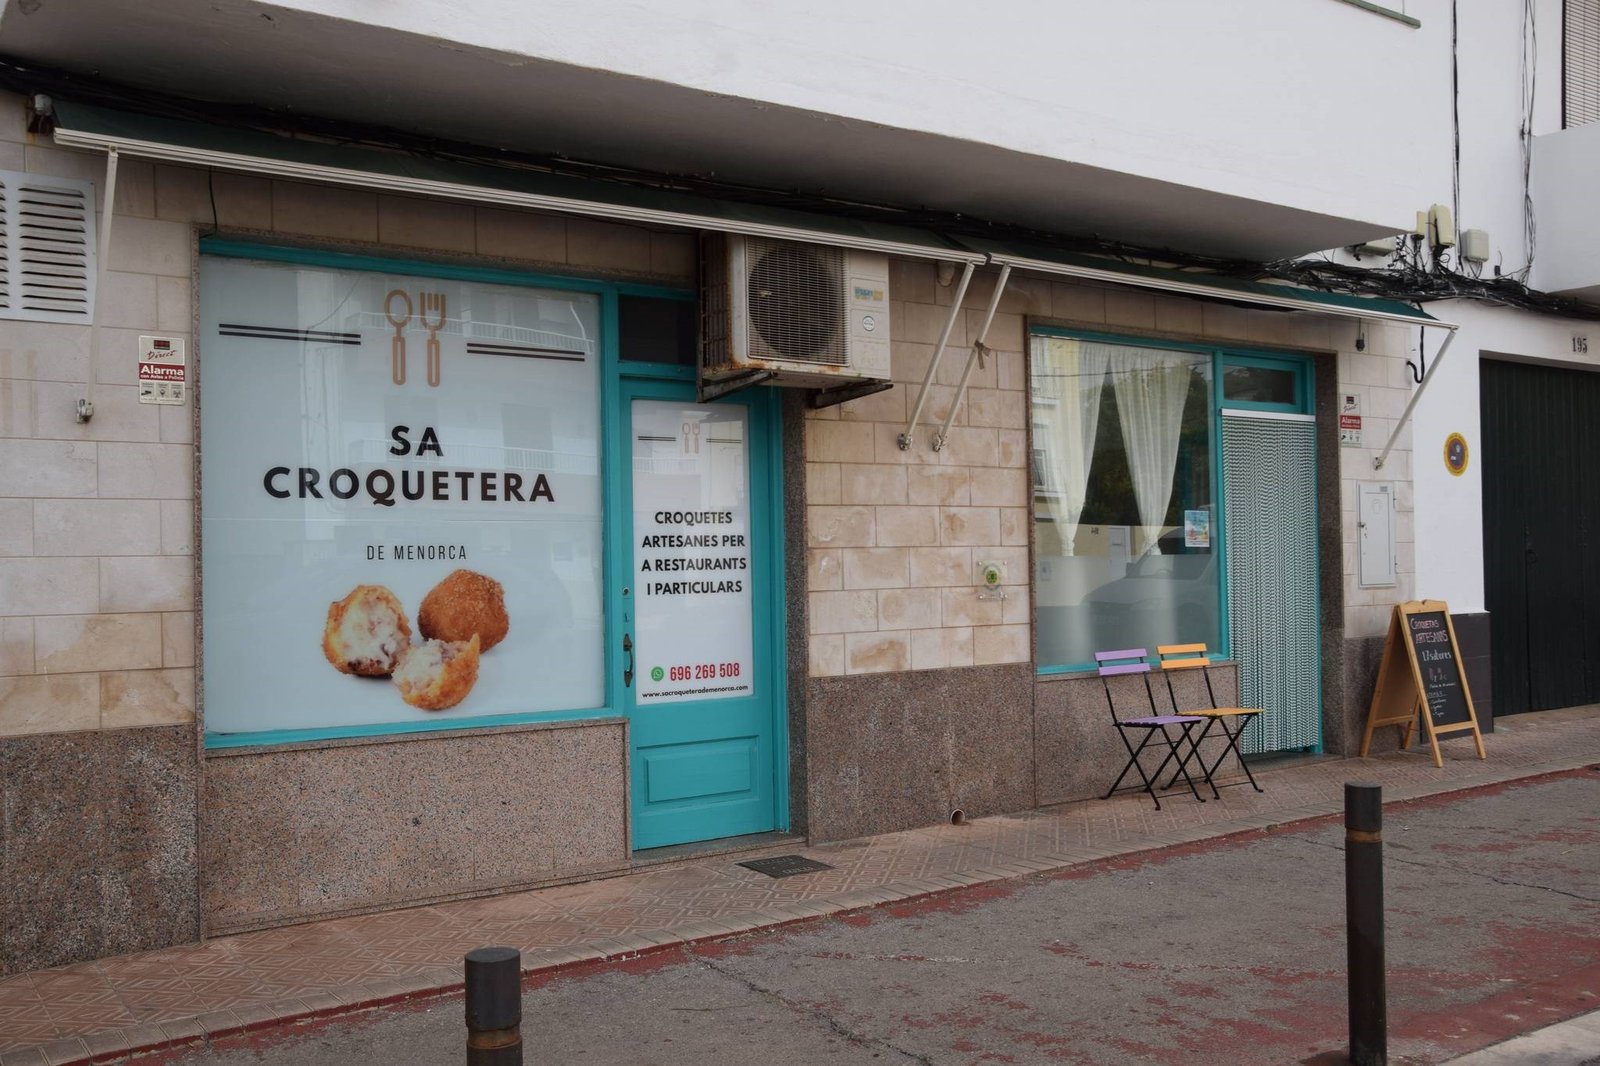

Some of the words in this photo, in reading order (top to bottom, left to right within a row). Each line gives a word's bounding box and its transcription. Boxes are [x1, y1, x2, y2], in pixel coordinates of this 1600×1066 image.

[1572, 336, 1588, 354] 195
[141, 365, 184, 376] Alarma
[390, 425, 443, 457] SA
[264, 467, 555, 507] CROQUETERA
[655, 511, 732, 526] CROQUETES
[642, 535, 718, 548] ARTESANES
[722, 534, 745, 547] PER
[367, 546, 384, 561] DE
[394, 545, 467, 561] MENORCA
[641, 559, 651, 572] A
[655, 557, 746, 571] RESTAURANTS
[647, 583, 651, 595] I
[655, 580, 742, 595] PARTICULARS
[670, 666, 691, 681] 696
[695, 664, 716, 680] 269
[719, 662, 740, 678] 508
[642, 685, 749, 698] www.sacroqueterademenorca.com
